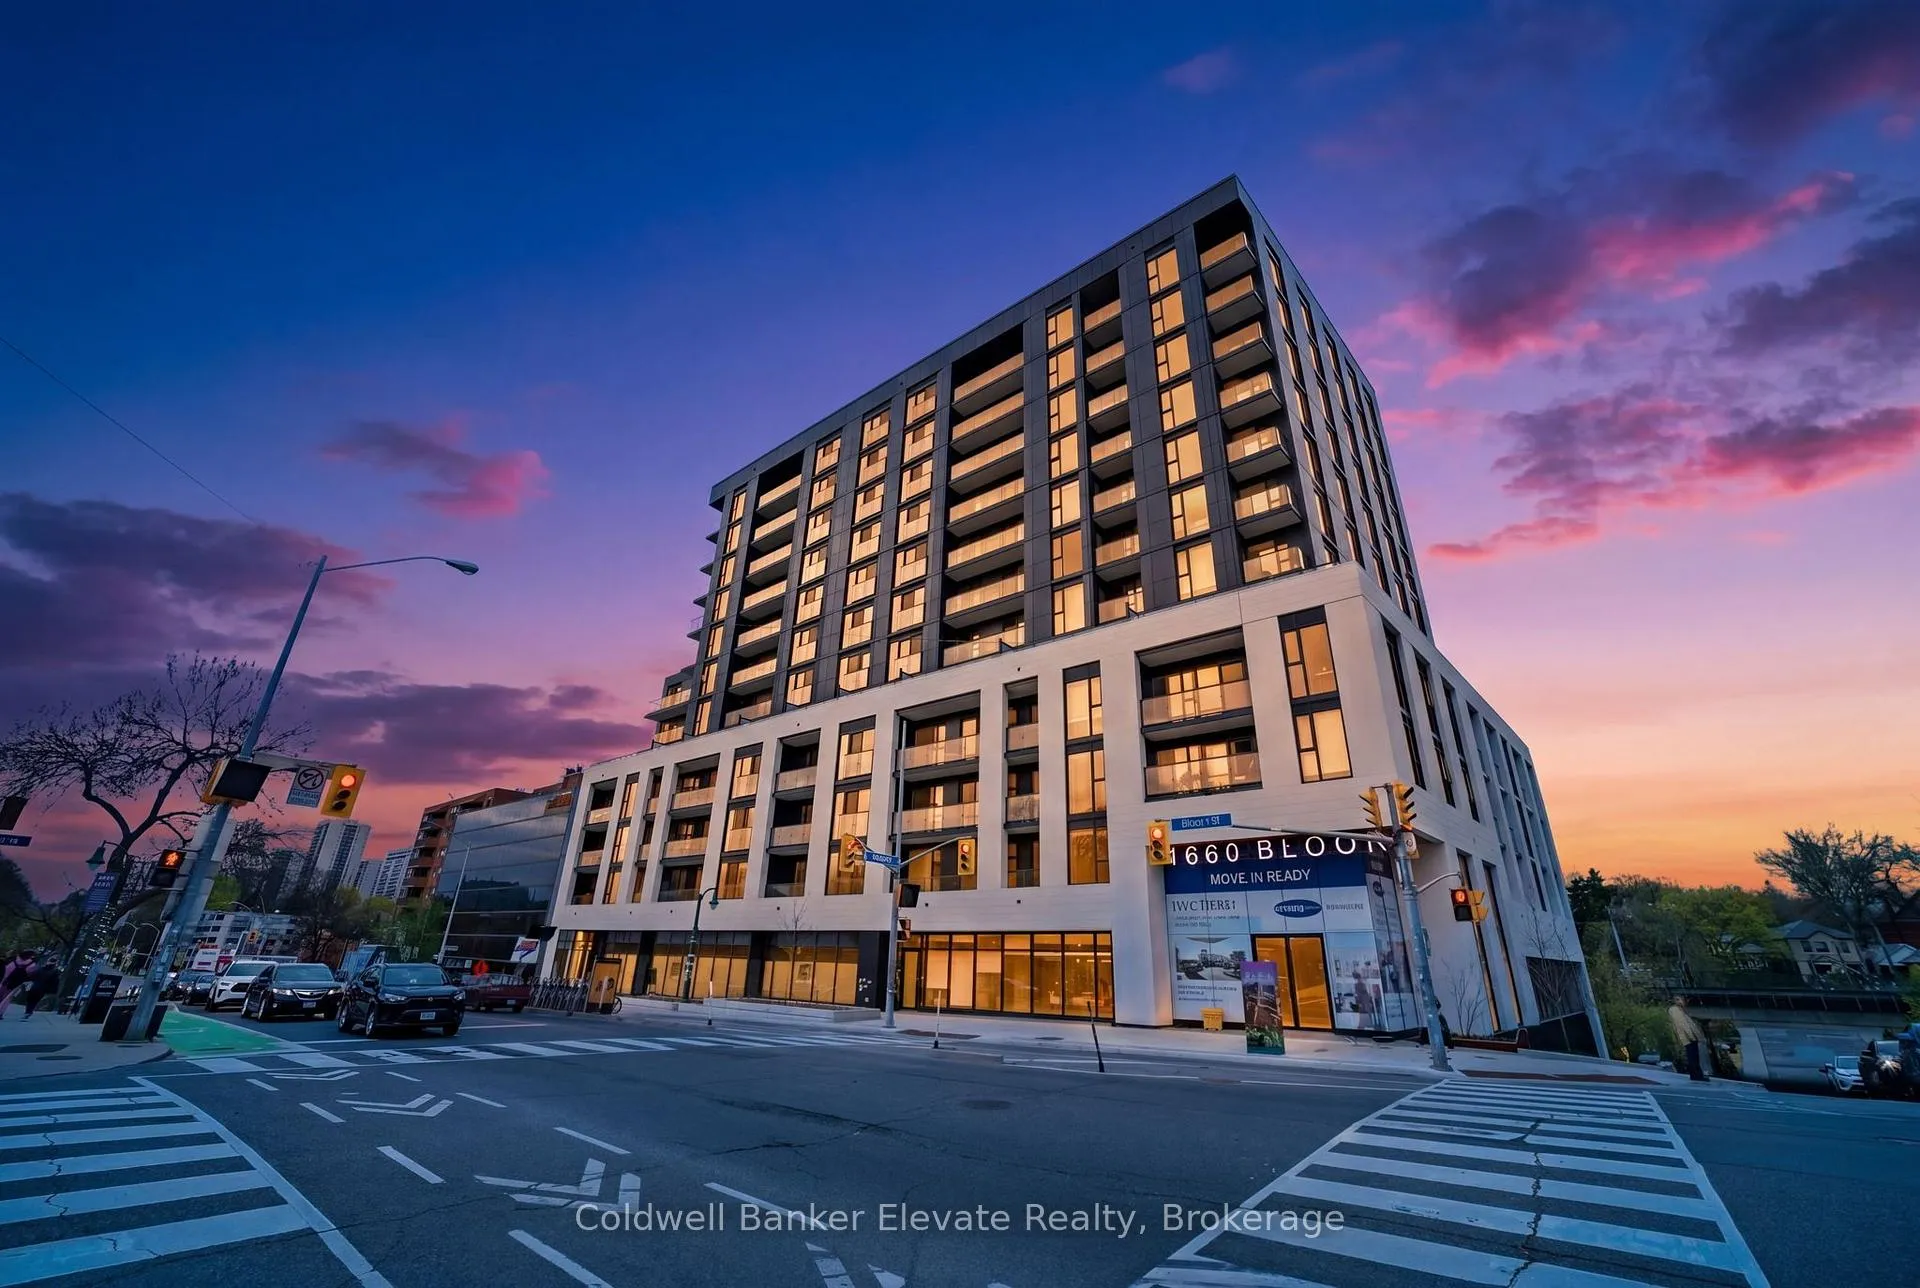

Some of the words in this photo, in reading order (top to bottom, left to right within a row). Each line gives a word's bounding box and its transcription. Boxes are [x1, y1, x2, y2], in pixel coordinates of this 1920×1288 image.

[1169, 842, 1239, 866] 1660
[1210, 872, 1247, 885] MOVE
[1251, 871, 1263, 884] IN
[1267, 869, 1311, 882] READY
